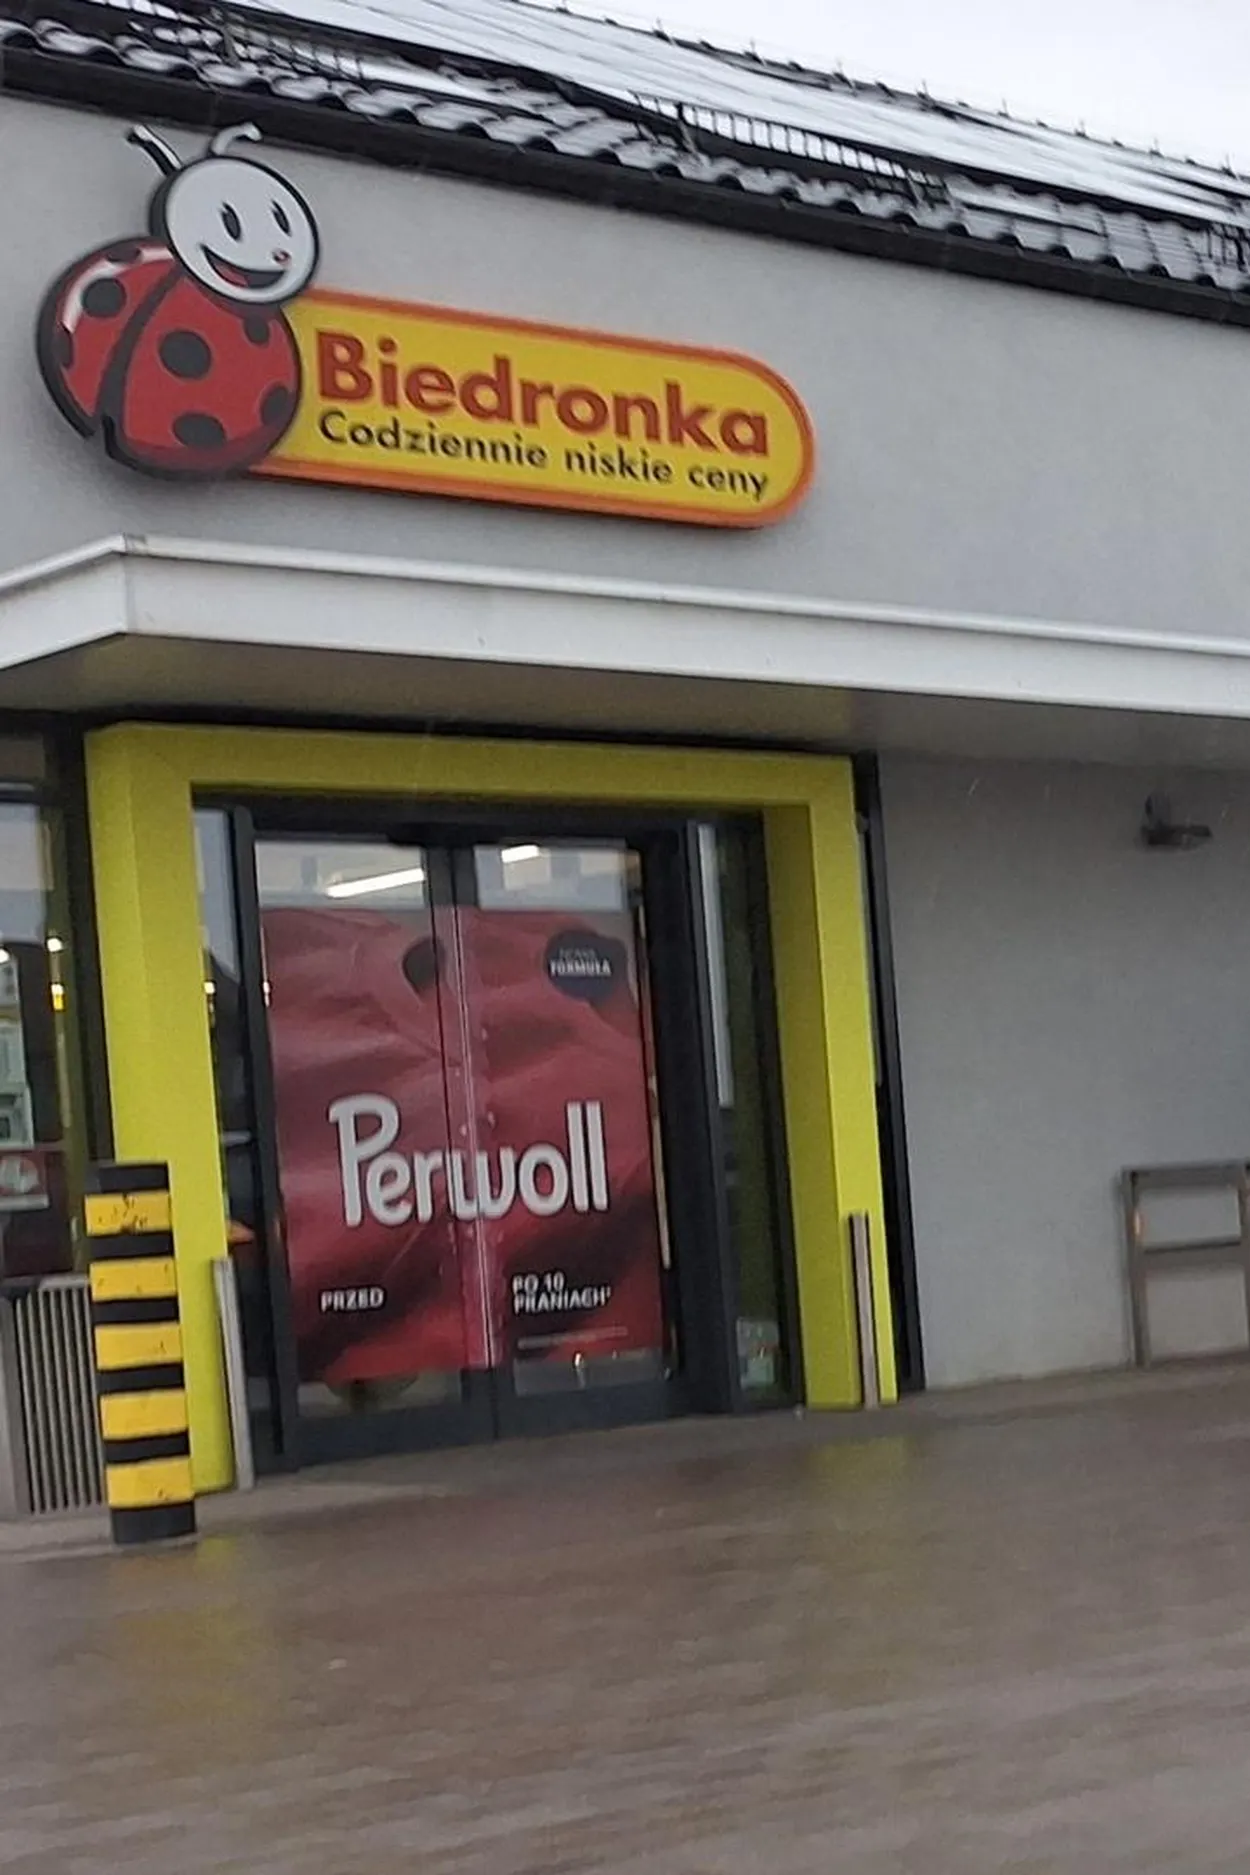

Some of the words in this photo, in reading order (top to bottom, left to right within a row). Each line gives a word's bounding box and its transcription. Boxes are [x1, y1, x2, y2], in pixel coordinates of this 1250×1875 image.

[316, 329, 769, 457] Biedronka
[319, 409, 548, 469] Codziennie
[564, 440, 672, 484] niskie
[688, 463, 768, 502] ceny
[328, 1092, 609, 1228] Perwoll
[321, 1287, 385, 1313] PRZED
[512, 1273, 539, 1295] PO
